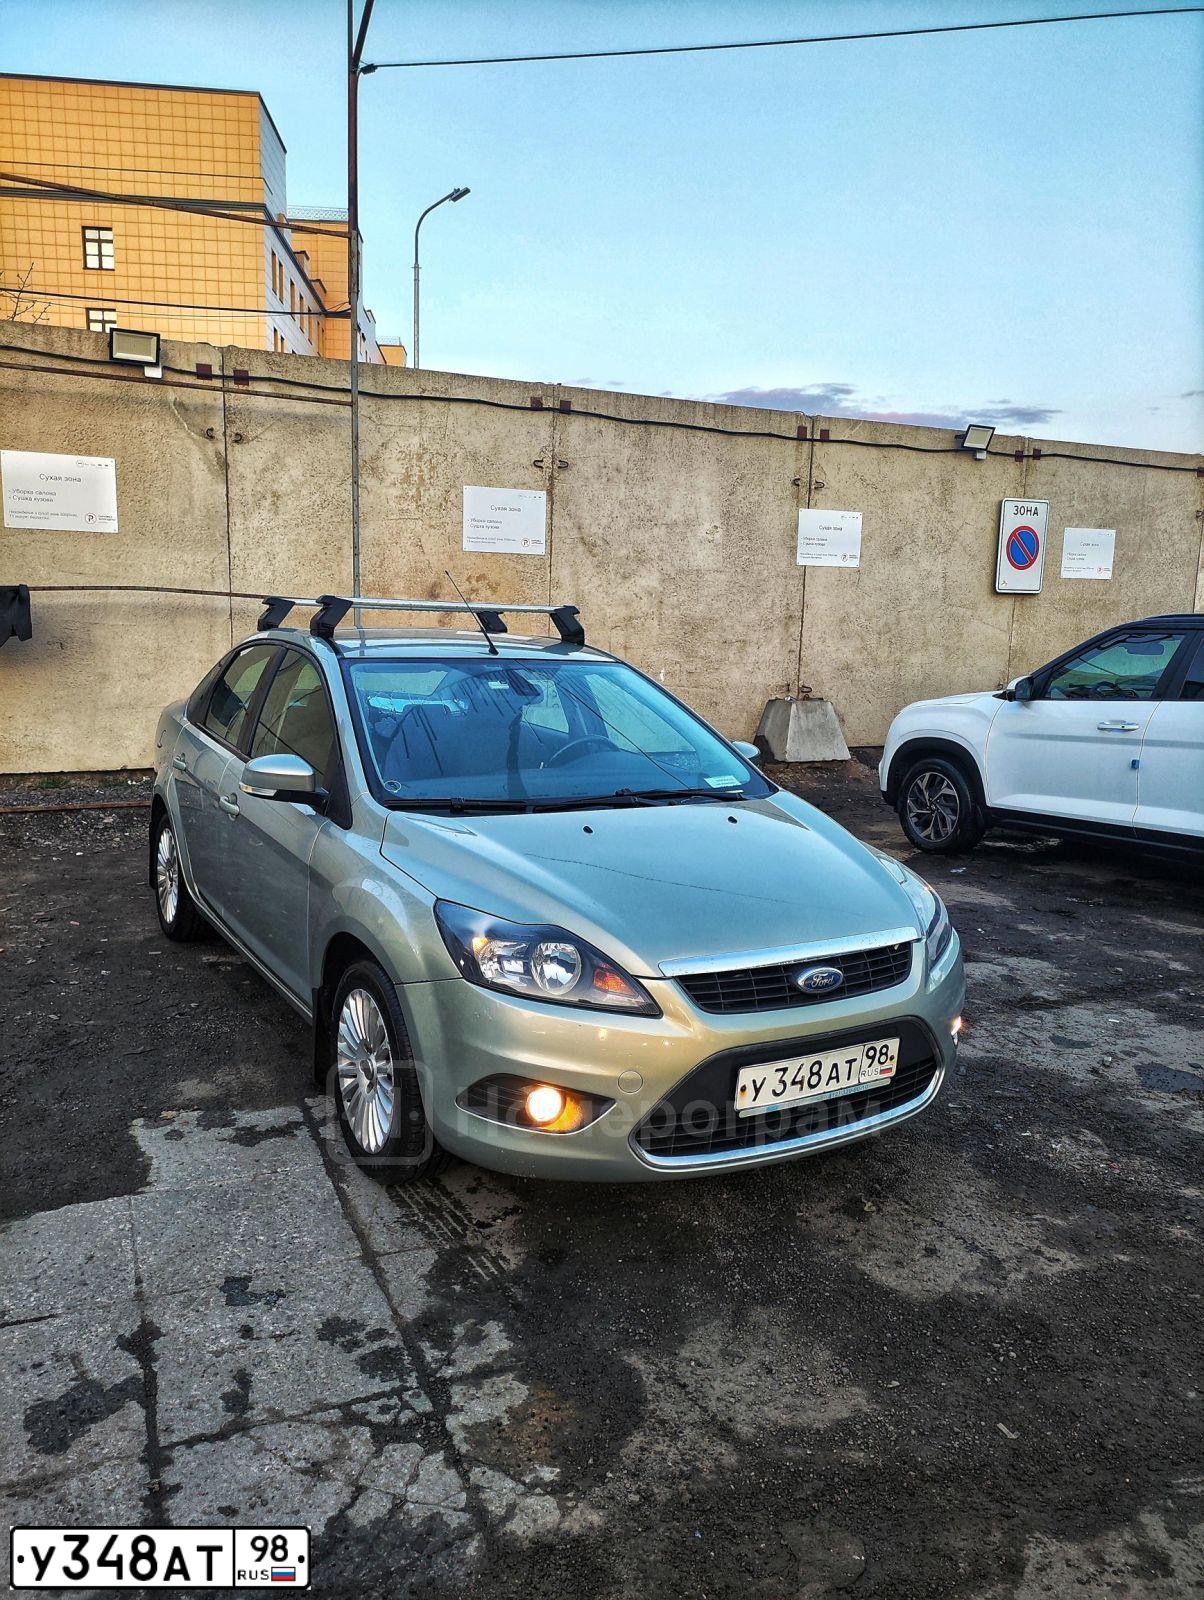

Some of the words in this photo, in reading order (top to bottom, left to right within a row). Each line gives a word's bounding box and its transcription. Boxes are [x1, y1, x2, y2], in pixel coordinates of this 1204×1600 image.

[39, 473, 62, 482] Сухая
[1013, 505, 1039, 517] ЗОНА
[811, 972, 834, 988] Ford
[865, 1043, 889, 1068] 98
[860, 1067, 879, 1078] RUS
